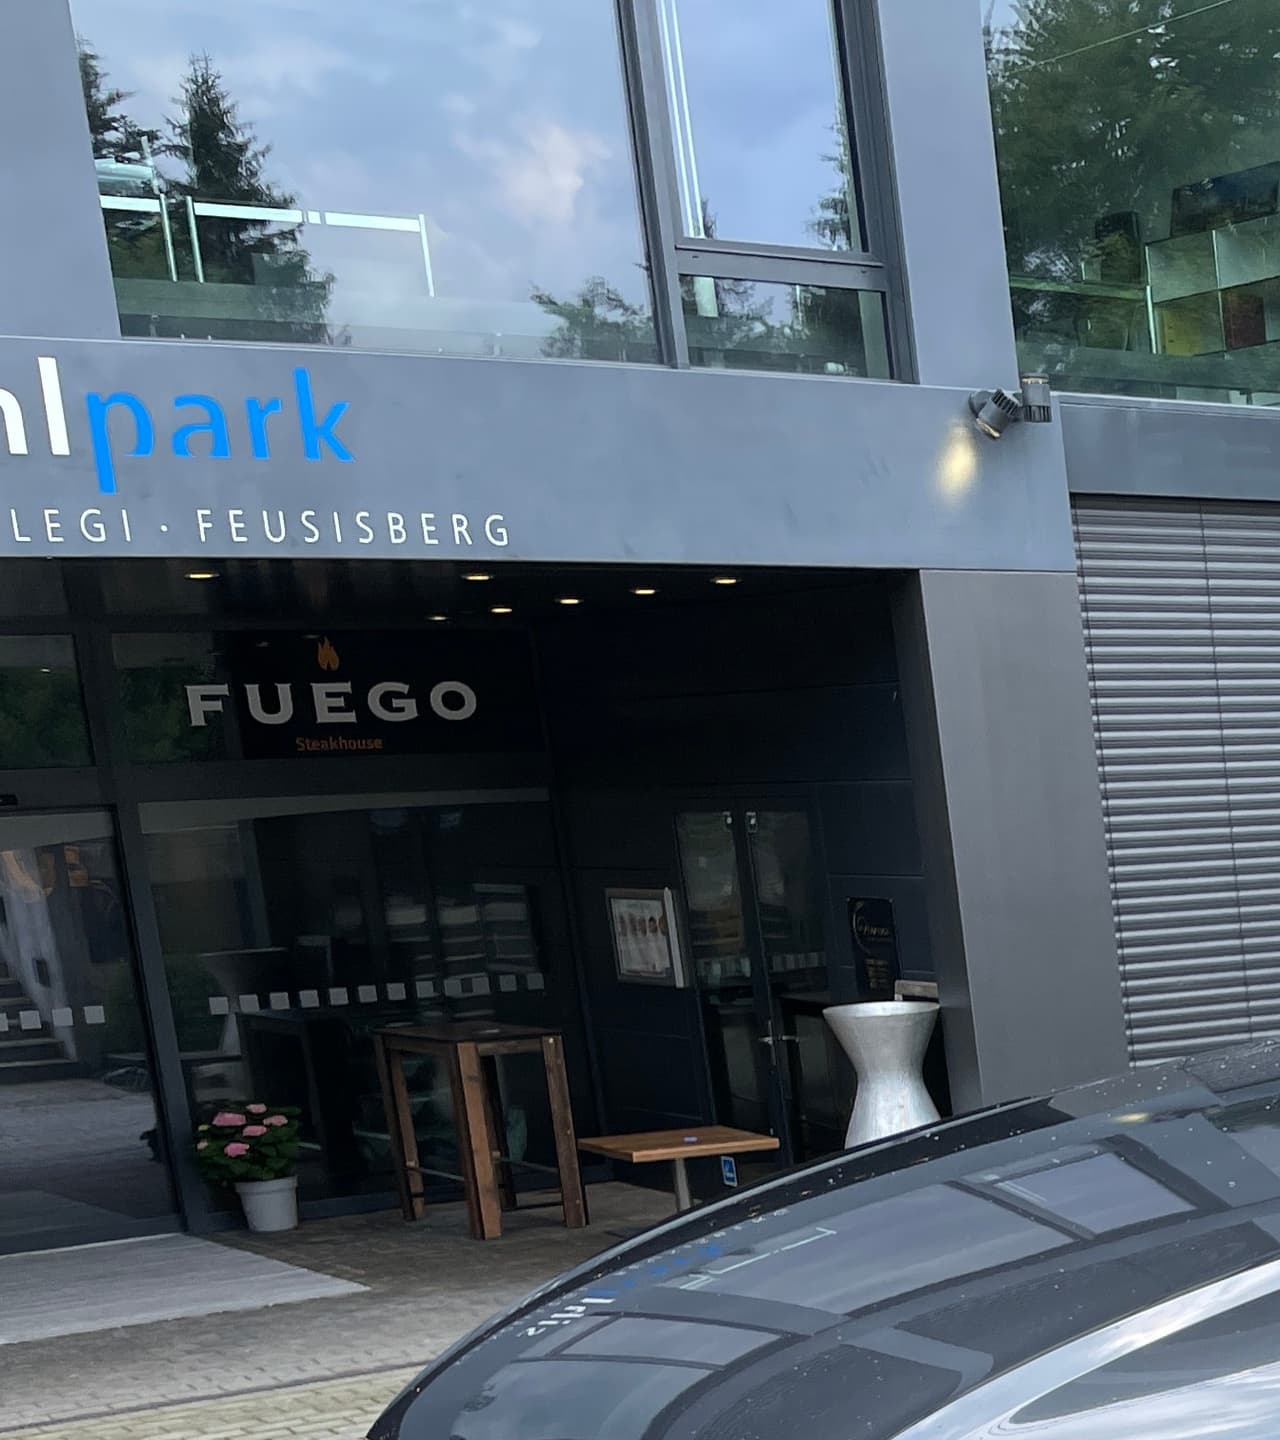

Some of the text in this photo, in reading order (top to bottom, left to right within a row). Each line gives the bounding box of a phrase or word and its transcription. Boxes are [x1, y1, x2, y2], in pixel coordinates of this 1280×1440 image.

[10, 508, 509, 547] LEGI FEUSISBERG
[184, 680, 477, 727] FUEGO
[295, 736, 383, 753] Steakhouse
